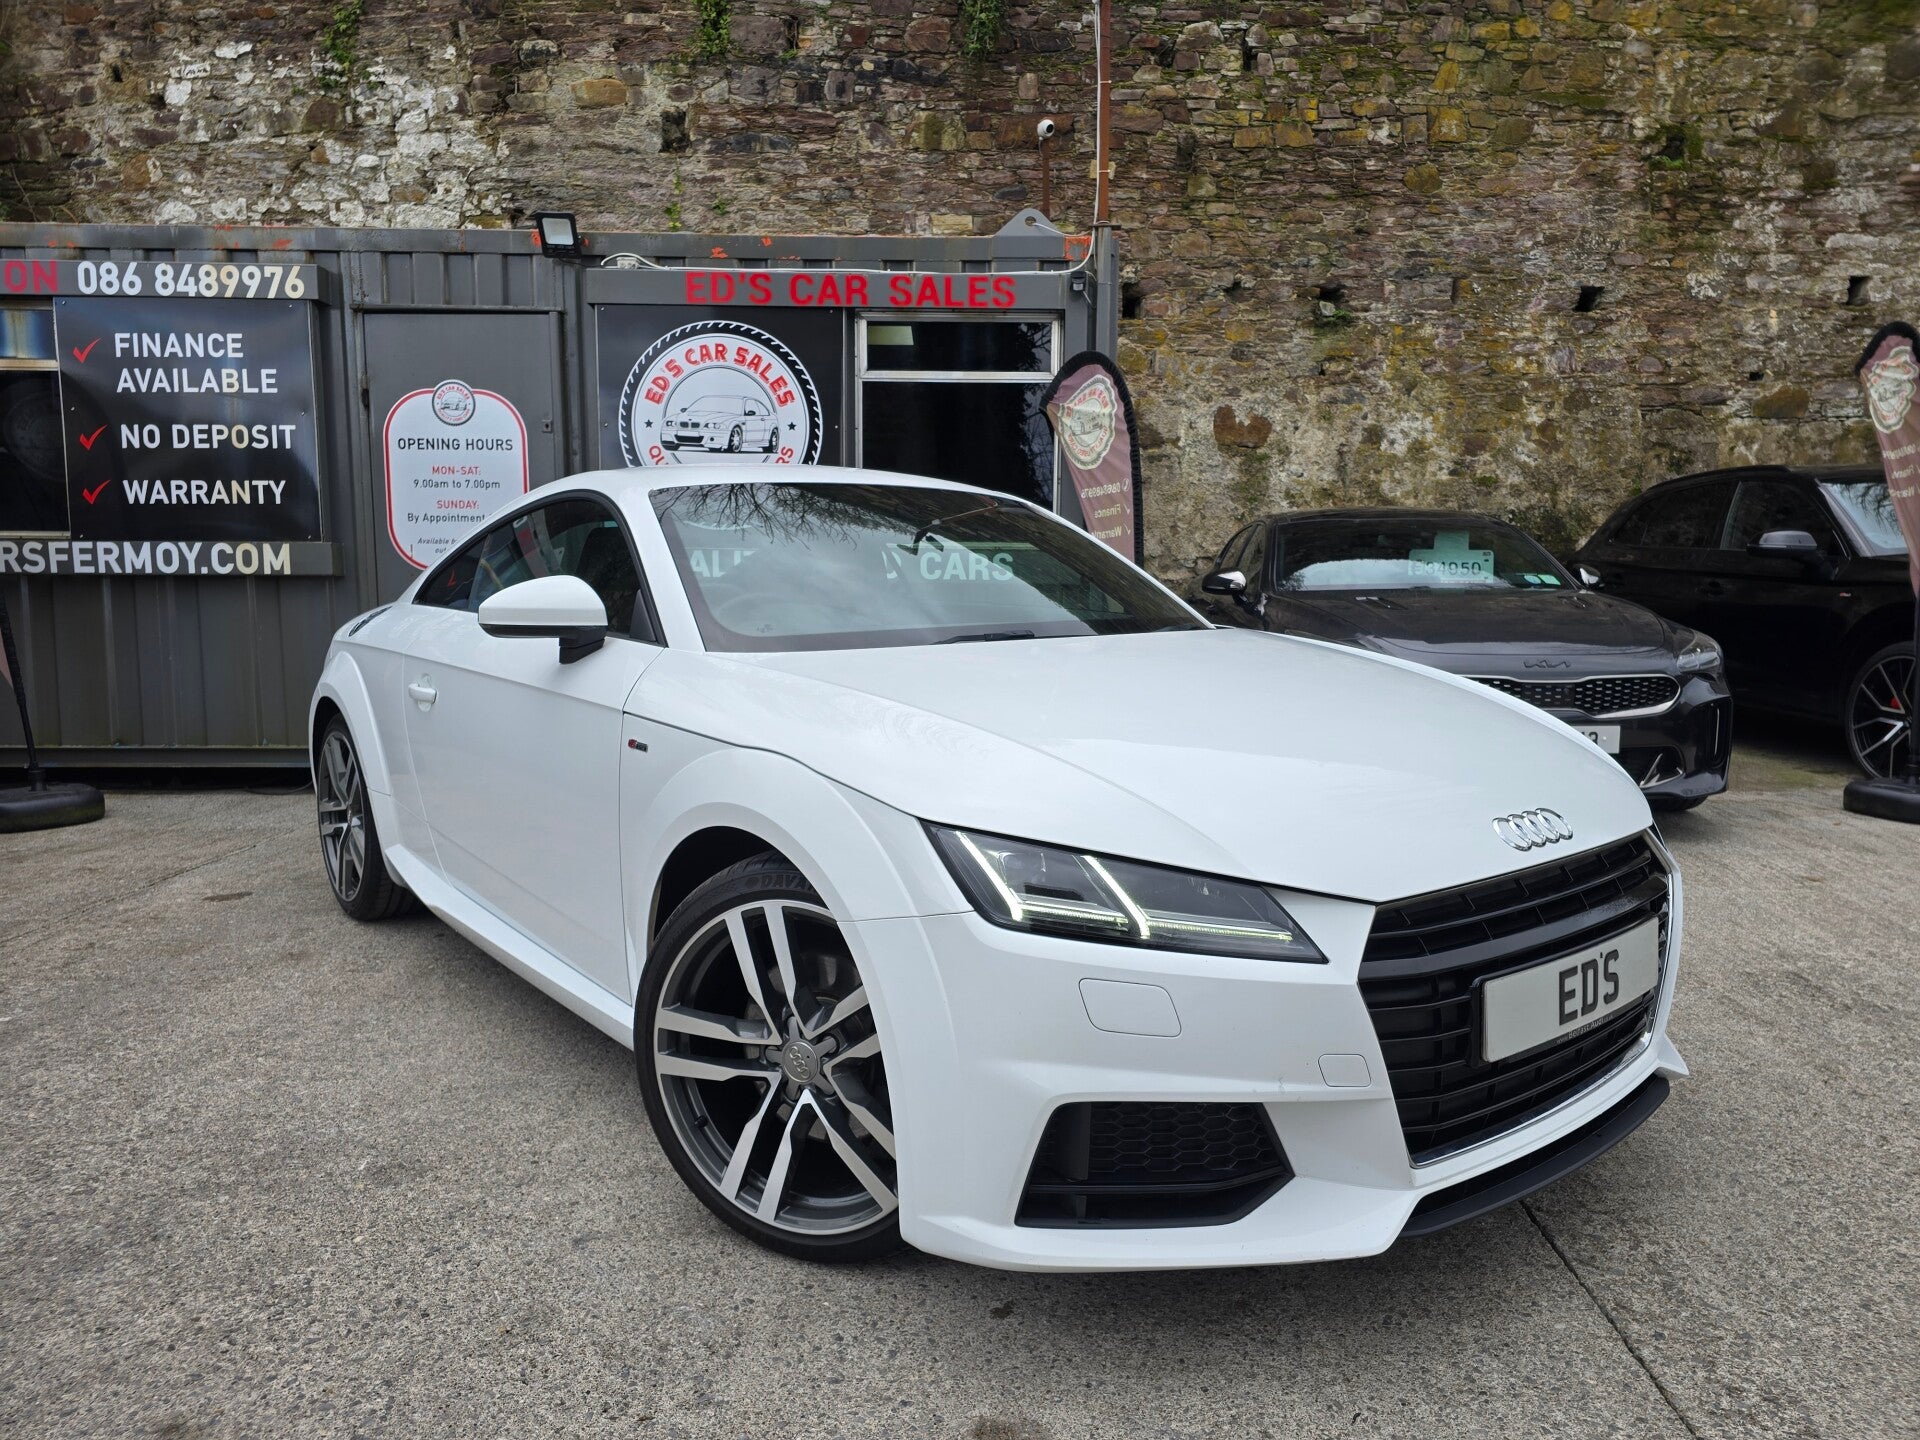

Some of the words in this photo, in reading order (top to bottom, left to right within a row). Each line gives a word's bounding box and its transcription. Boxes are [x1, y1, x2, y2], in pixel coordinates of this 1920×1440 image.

[4, 259, 58, 293] ON
[77, 261, 142, 295] 086
[154, 263, 305, 299] 8489976
[685, 270, 772, 305] ED'S
[789, 274, 868, 306] CAR
[889, 275, 1016, 309] SALES
[115, 332, 244, 358] FINANCE
[116, 368, 278, 393] AVAILABLE
[644, 358, 685, 405] ED'S
[685, 343, 729, 366] CAR
[733, 346, 795, 408] SALES
[120, 424, 161, 449] NO
[172, 424, 297, 449] DEPOSIT
[397, 437, 461, 451] OPENING
[465, 438, 514, 451] HOURS
[431, 465, 482, 475] MON-SAT:
[123, 479, 286, 505] WARRANTY
[413, 479, 449, 489] 9.00am
[452, 479, 462, 488] to
[465, 479, 501, 491] 7.00pm
[436, 500, 480, 510] SUNDAY:
[407, 512, 420, 524] By
[423, 512, 485, 524] Appointment
[417, 537, 449, 545] Available
[0, 542, 291, 575] RSFERMOY.COM
[919, 551, 1014, 581] CARS
[1559, 950, 1619, 1026] ED'S
